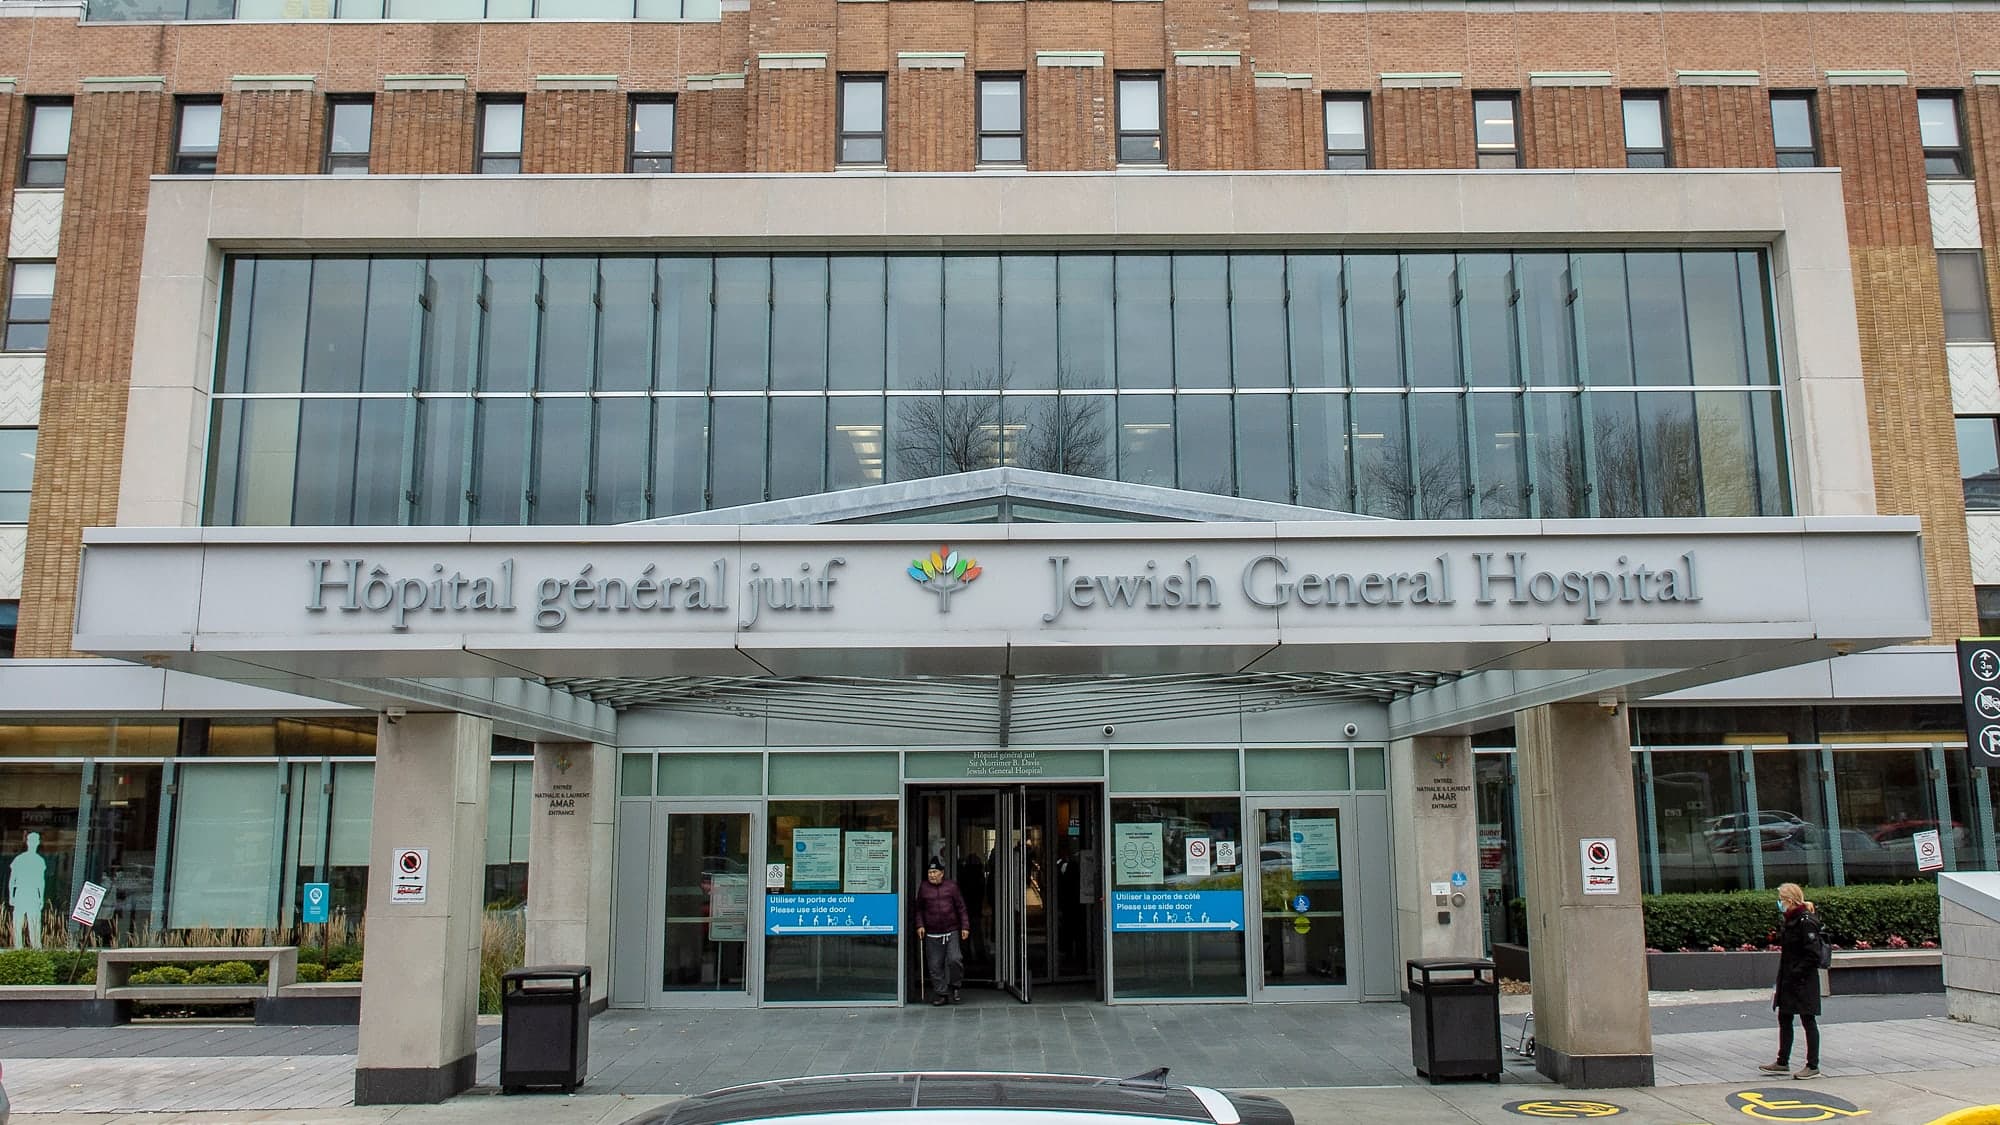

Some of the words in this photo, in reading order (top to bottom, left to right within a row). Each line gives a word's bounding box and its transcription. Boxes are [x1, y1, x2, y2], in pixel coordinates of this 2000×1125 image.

[1041, 554, 1222, 623] Jewish
[1242, 550, 1457, 609] General
[1471, 550, 1704, 622] Hospital
[304, 557, 517, 631] Hôpital
[532, 558, 730, 630] général
[739, 556, 847, 630] juif
[1013, 759, 1019, 767] B.
[1021, 759, 1040, 767] Davis
[966, 767, 988, 776] Jewish
[988, 767, 1014, 775] General
[1015, 767, 1043, 776] Hospital
[1432, 792, 1457, 801] AMAR
[550, 799, 575, 808] AMAR
[770, 896, 796, 904] Utiliser
[806, 896, 826, 905] porte
[838, 895, 855, 903] côté
[1152, 894, 1172, 902] porte
[1184, 892, 1201, 900] côté
